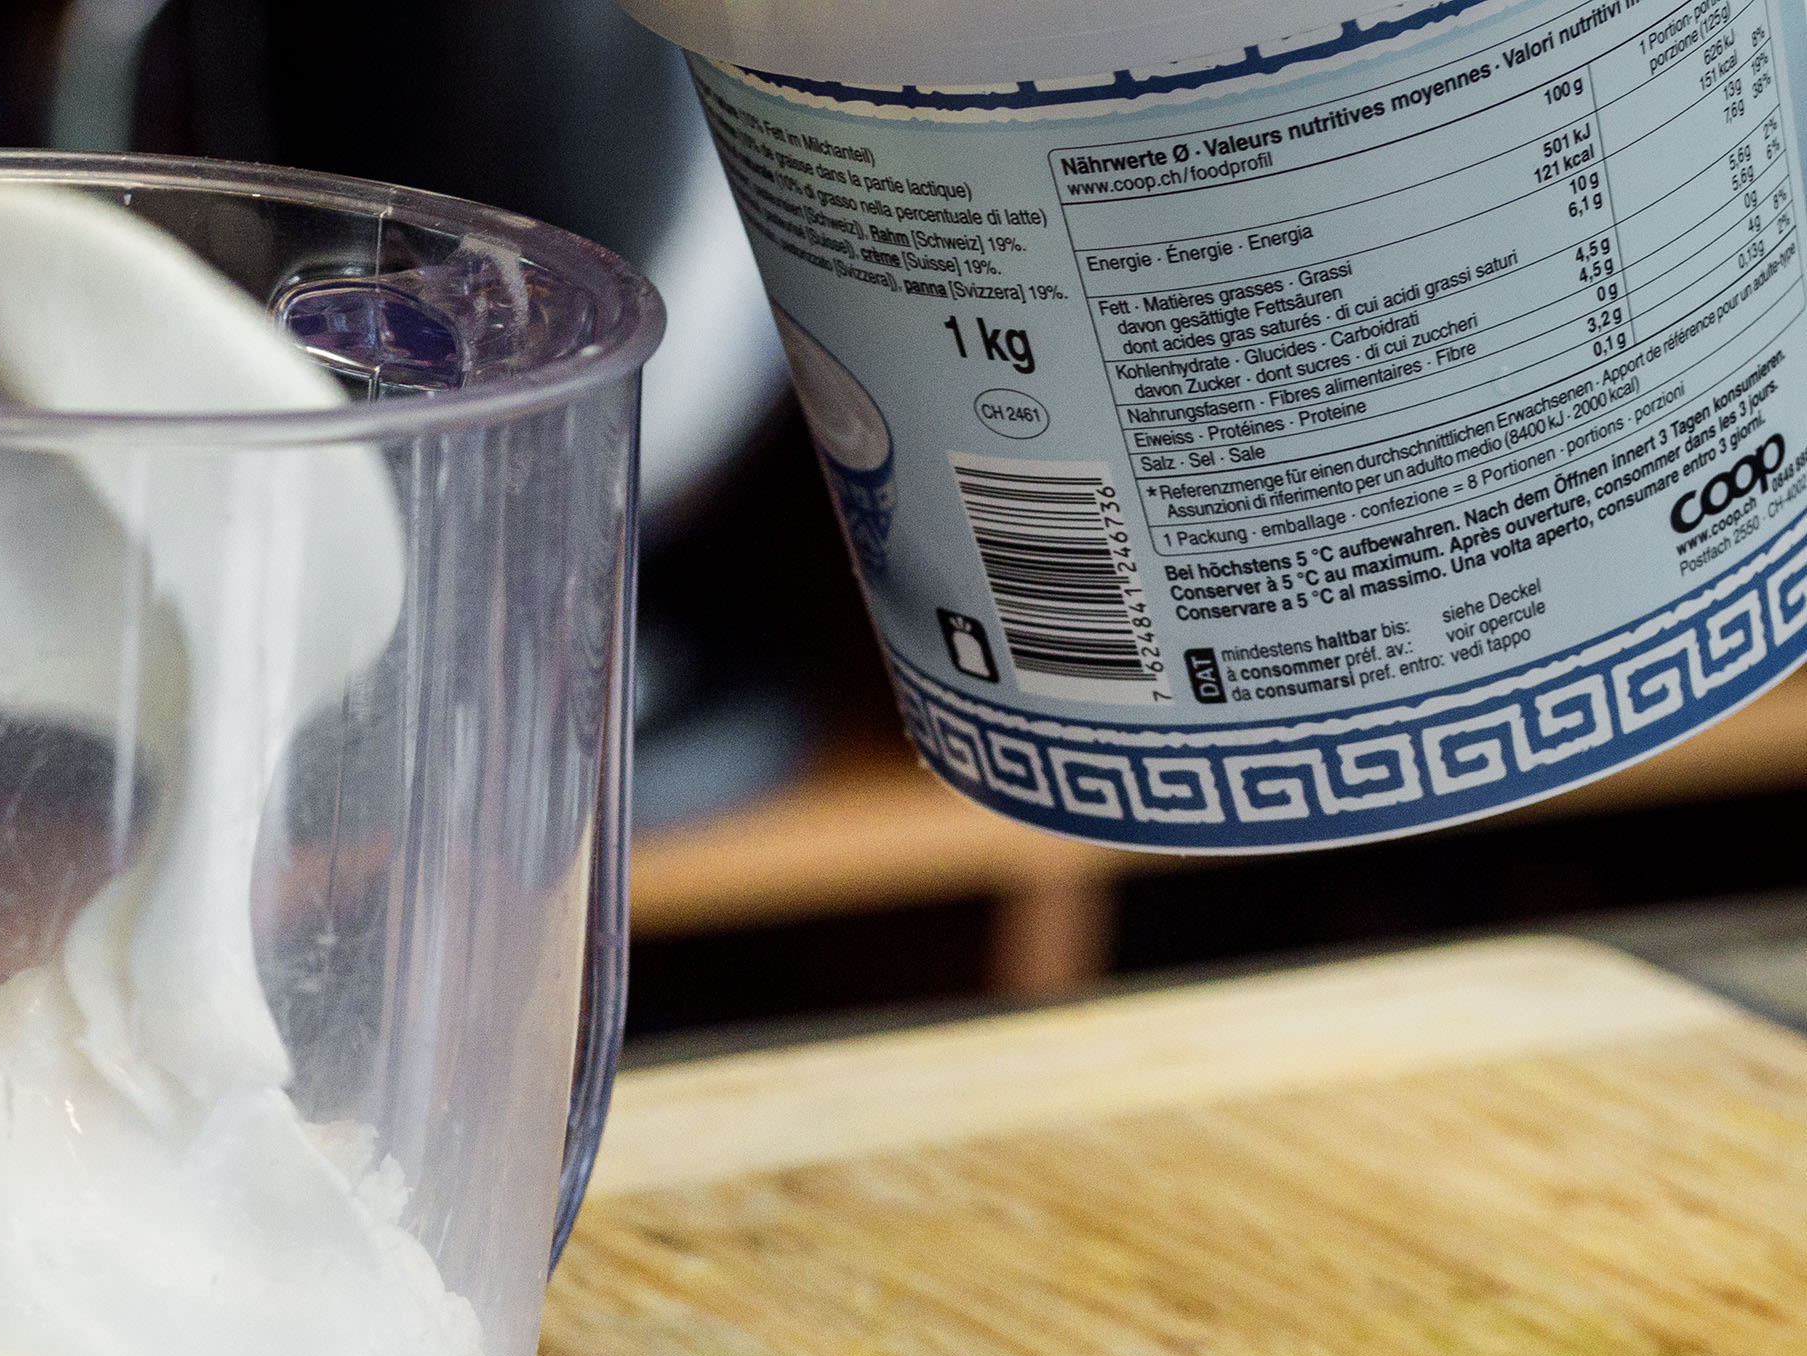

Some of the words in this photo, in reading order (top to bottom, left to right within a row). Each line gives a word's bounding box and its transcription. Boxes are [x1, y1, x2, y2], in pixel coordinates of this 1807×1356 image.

[1059, 149, 1168, 176] Nährwerte
[1171, 142, 1190, 164] Ø
[1202, 128, 1283, 157] Valeurs
[1287, 100, 1385, 140] nutritives
[1389, 63, 1492, 111] moyennes
[1501, 30, 1554, 68] Valori
[1558, 0, 1621, 45] nutritivi
[1543, 80, 1571, 105] 100
[1572, 77, 1584, 96] g
[1533, 159, 1560, 184] 121
[1562, 142, 1595, 171] kcal
[1542, 132, 1570, 158] 501
[1571, 121, 1591, 144] kJ
[1066, 150, 1273, 196] www.coop.ch/foodprofil
[859, 245, 902, 269] crème
[900, 250, 962, 277] [Suisse]
[962, 258, 1002, 275] 19%.
[867, 223, 912, 248] Rahm
[909, 228, 985, 255] [Schweiz]
[986, 236, 1026, 252] 19%.
[1085, 251, 1152, 273] Energie
[1164, 240, 1233, 264] Énergie
[1246, 224, 1314, 251] Energia
[1574, 239, 1598, 262] 4,5
[1599, 236, 1610, 255] g
[902, 278, 948, 298] panna
[947, 279, 1027, 304] [Svizzera]
[1027, 284, 1068, 300] 19%.
[1097, 299, 1131, 316] Fett
[1141, 291, 1215, 312] Matières
[1217, 279, 1284, 307] grasses
[1297, 259, 1353, 287] Grassi
[1116, 318, 1167, 335] davon
[1169, 305, 1250, 334] gesättigte
[1253, 287, 1343, 317] Fettsäuren
[1121, 337, 1160, 355] dont
[1161, 332, 1216, 352] acides
[1218, 326, 1256, 348] gras
[1258, 311, 1321, 337] saturés
[1334, 302, 1351, 321] di
[1353, 295, 1379, 316] cui
[1382, 282, 1421, 308] acidi
[1423, 265, 1472, 299] grassi
[1474, 248, 1518, 278] saturi
[944, 315, 967, 358] 1
[978, 318, 1036, 374] kg
[1114, 355, 1230, 380] Kohlenhydrate
[1243, 339, 1317, 365] Glucides
[1329, 309, 1420, 347] Carboidrati
[1586, 309, 1611, 333] 3,2
[1611, 306, 1622, 325] g
[1126, 398, 1255, 424] Nahrungsfasern
[1267, 385, 1321, 407] Fibres
[1324, 359, 1423, 396] alimentaires
[1434, 342, 1476, 366] Fibre
[981, 404, 1004, 420] CH
[1007, 407, 1041, 423] 2461
[1132, 429, 1195, 448] Eiweiss
[1206, 418, 1285, 441] Protéines
[1297, 400, 1367, 427] Proteine
[1284, 467, 1307, 484] für
[1309, 460, 1354, 480] einen
[1354, 419, 1495, 470] durchschnittlichen
[1495, 379, 1593, 429] Erwachsenen
[1601, 352, 1645, 386] Apport
[1139, 454, 1176, 472] Salz
[1187, 450, 1216, 468] Sel
[1227, 444, 1266, 463] Sale
[1166, 495, 1251, 518] Assunzioni
[1251, 492, 1268, 509] di
[1268, 479, 1354, 507] riferimento
[1354, 472, 1381, 494] per
[1382, 467, 1404, 484] un
[1405, 453, 1454, 478] adulto
[1454, 437, 1502, 463] medio
[1503, 417, 1546, 450] (8400
[1546, 409, 1564, 430] kJ
[1571, 391, 1607, 420] 2000
[1607, 375, 1639, 402] kcal)
[1162, 532, 1172, 547] 1
[1175, 527, 1248, 546] Packung
[1260, 511, 1346, 538] emballage
[1359, 485, 1449, 519] confezione
[1466, 473, 1478, 490] 8
[1480, 447, 1556, 485] Portionen
[1565, 417, 1624, 457] portions
[1163, 563, 1195, 581] Bei
[1295, 549, 1308, 567] 5
[1310, 544, 1334, 563] °C
[1338, 519, 1460, 559] aufbewahren.
[1463, 499, 1509, 527] Nach
[1512, 486, 1550, 510] dem
[1553, 461, 1608, 494] Öffnen
[1610, 435, 1656, 470] innert
[1657, 427, 1668, 446] 3
[1669, 405, 1710, 437] Tagen
[1169, 580, 1261, 601] Conserver
[1265, 575, 1279, 592] à
[1280, 573, 1294, 590] 5
[1296, 568, 1320, 586] °C
[1323, 567, 1347, 583] au
[1350, 545, 1445, 578] maximum.
[1449, 526, 1501, 554] Après
[1504, 493, 1591, 535] ouverture,
[1593, 445, 1681, 500] consommer
[1684, 424, 1716, 453] dans
[1717, 410, 1737, 431] les
[1738, 399, 1746, 417] 3
[1670, 433, 1786, 534] coop
[1174, 599, 1277, 621] Conservare
[1280, 597, 1293, 611] a
[1295, 591, 1308, 609] 5
[1310, 586, 1334, 604] °C
[1338, 582, 1355, 601] al
[1359, 565, 1447, 597] massimo.
[1449, 552, 1486, 574] Una
[1489, 536, 1532, 561] volta
[1535, 514, 1594, 546] aperto,
[1596, 469, 1679, 520] consumare
[1682, 447, 1716, 477] entro
[1718, 436, 1727, 454] 3
[1675, 496, 1756, 556] www.coop.ch
[1220, 639, 1313, 662] mindestens
[1314, 627, 1377, 651] haltbar
[1379, 620, 1410, 638] bis:
[1441, 600, 1485, 623] siehe
[1487, 577, 1541, 609] Deckel
[1226, 666, 1238, 682] à
[1239, 655, 1341, 681] consommer
[1344, 644, 1382, 672] préf.
[1385, 640, 1413, 658] av.:
[1445, 623, 1474, 643] voir
[1478, 600, 1545, 635] opercule
[1191, 655, 1220, 697] DAT
[1230, 685, 1252, 702] da
[1254, 668, 1356, 700] consumarsi
[1358, 662, 1395, 688] pref.
[1398, 654, 1445, 676] entro:
[1449, 638, 1484, 663] vedi
[1485, 627, 1531, 652] tappo
